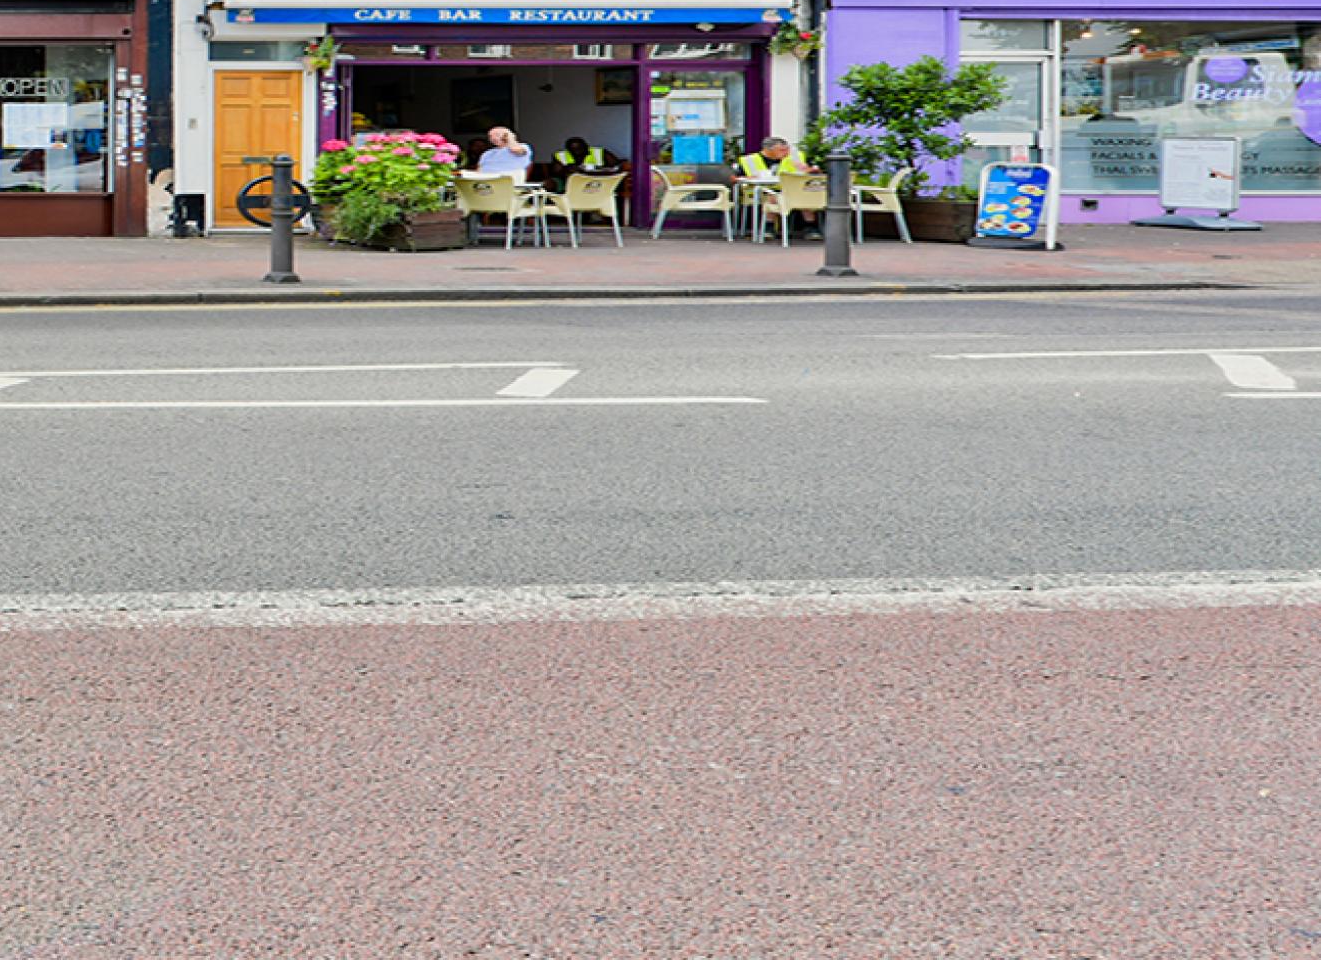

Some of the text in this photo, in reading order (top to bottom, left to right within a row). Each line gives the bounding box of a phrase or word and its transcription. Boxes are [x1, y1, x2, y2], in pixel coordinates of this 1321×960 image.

[354, 10, 655, 21] CAFE BAR RESTAURANT
[2, 78, 67, 96] OPEN
[1090, 138, 1153, 147] WAXING
[1090, 151, 1145, 160] FACIALS
